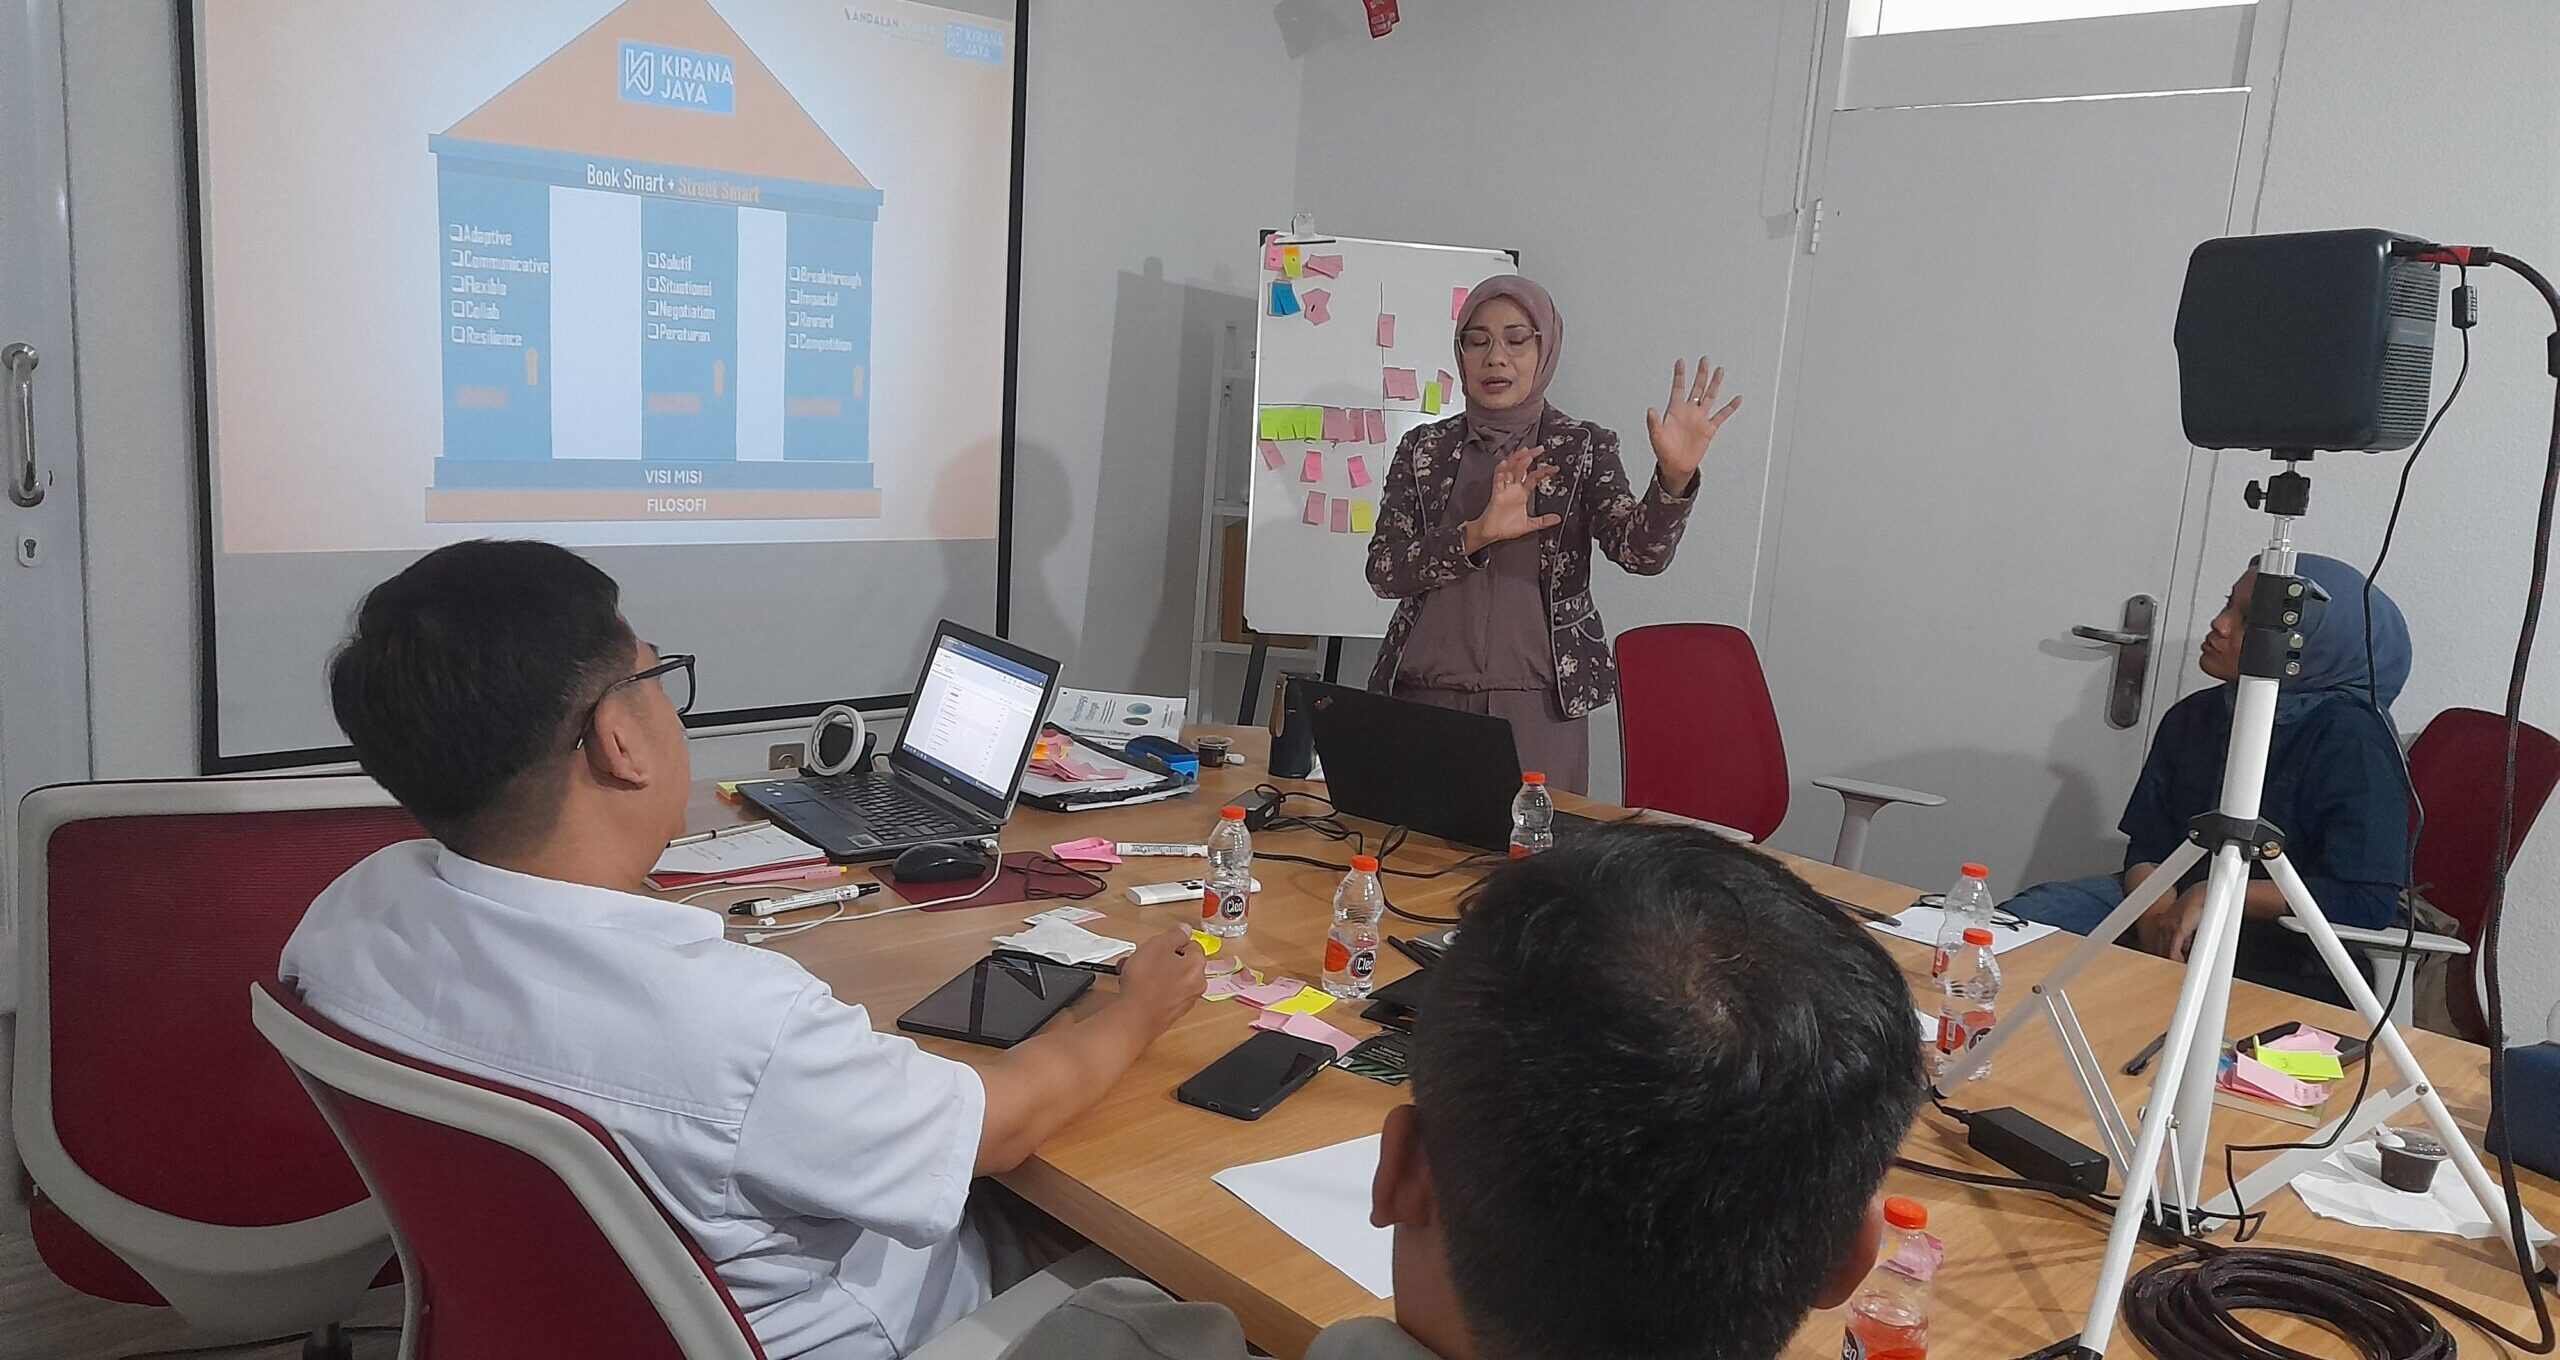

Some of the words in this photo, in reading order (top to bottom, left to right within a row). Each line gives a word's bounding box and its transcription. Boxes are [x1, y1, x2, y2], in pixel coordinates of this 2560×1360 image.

[661, 54, 734, 85] KIRANA
[660, 79, 708, 105] JAYA
[587, 163, 620, 188] Book
[623, 168, 665, 193] Smart
[678, 176, 720, 198] Street
[720, 180, 761, 203] Smart
[463, 224, 512, 247] Adaptive
[464, 250, 549, 274] Communicative
[464, 275, 507, 296] Flexible
[659, 276, 712, 297] Situational
[800, 266, 862, 289] Breakthrough
[466, 301, 500, 320] Collab
[659, 300, 716, 321] Negotiation
[466, 326, 522, 346] Resilience
[659, 323, 710, 343] Peraturan
[644, 469, 671, 484] VISI
[674, 469, 703, 484] MISI
[647, 498, 707, 513] FILOSOFI
[1226, 899, 1243, 914] Cleo
